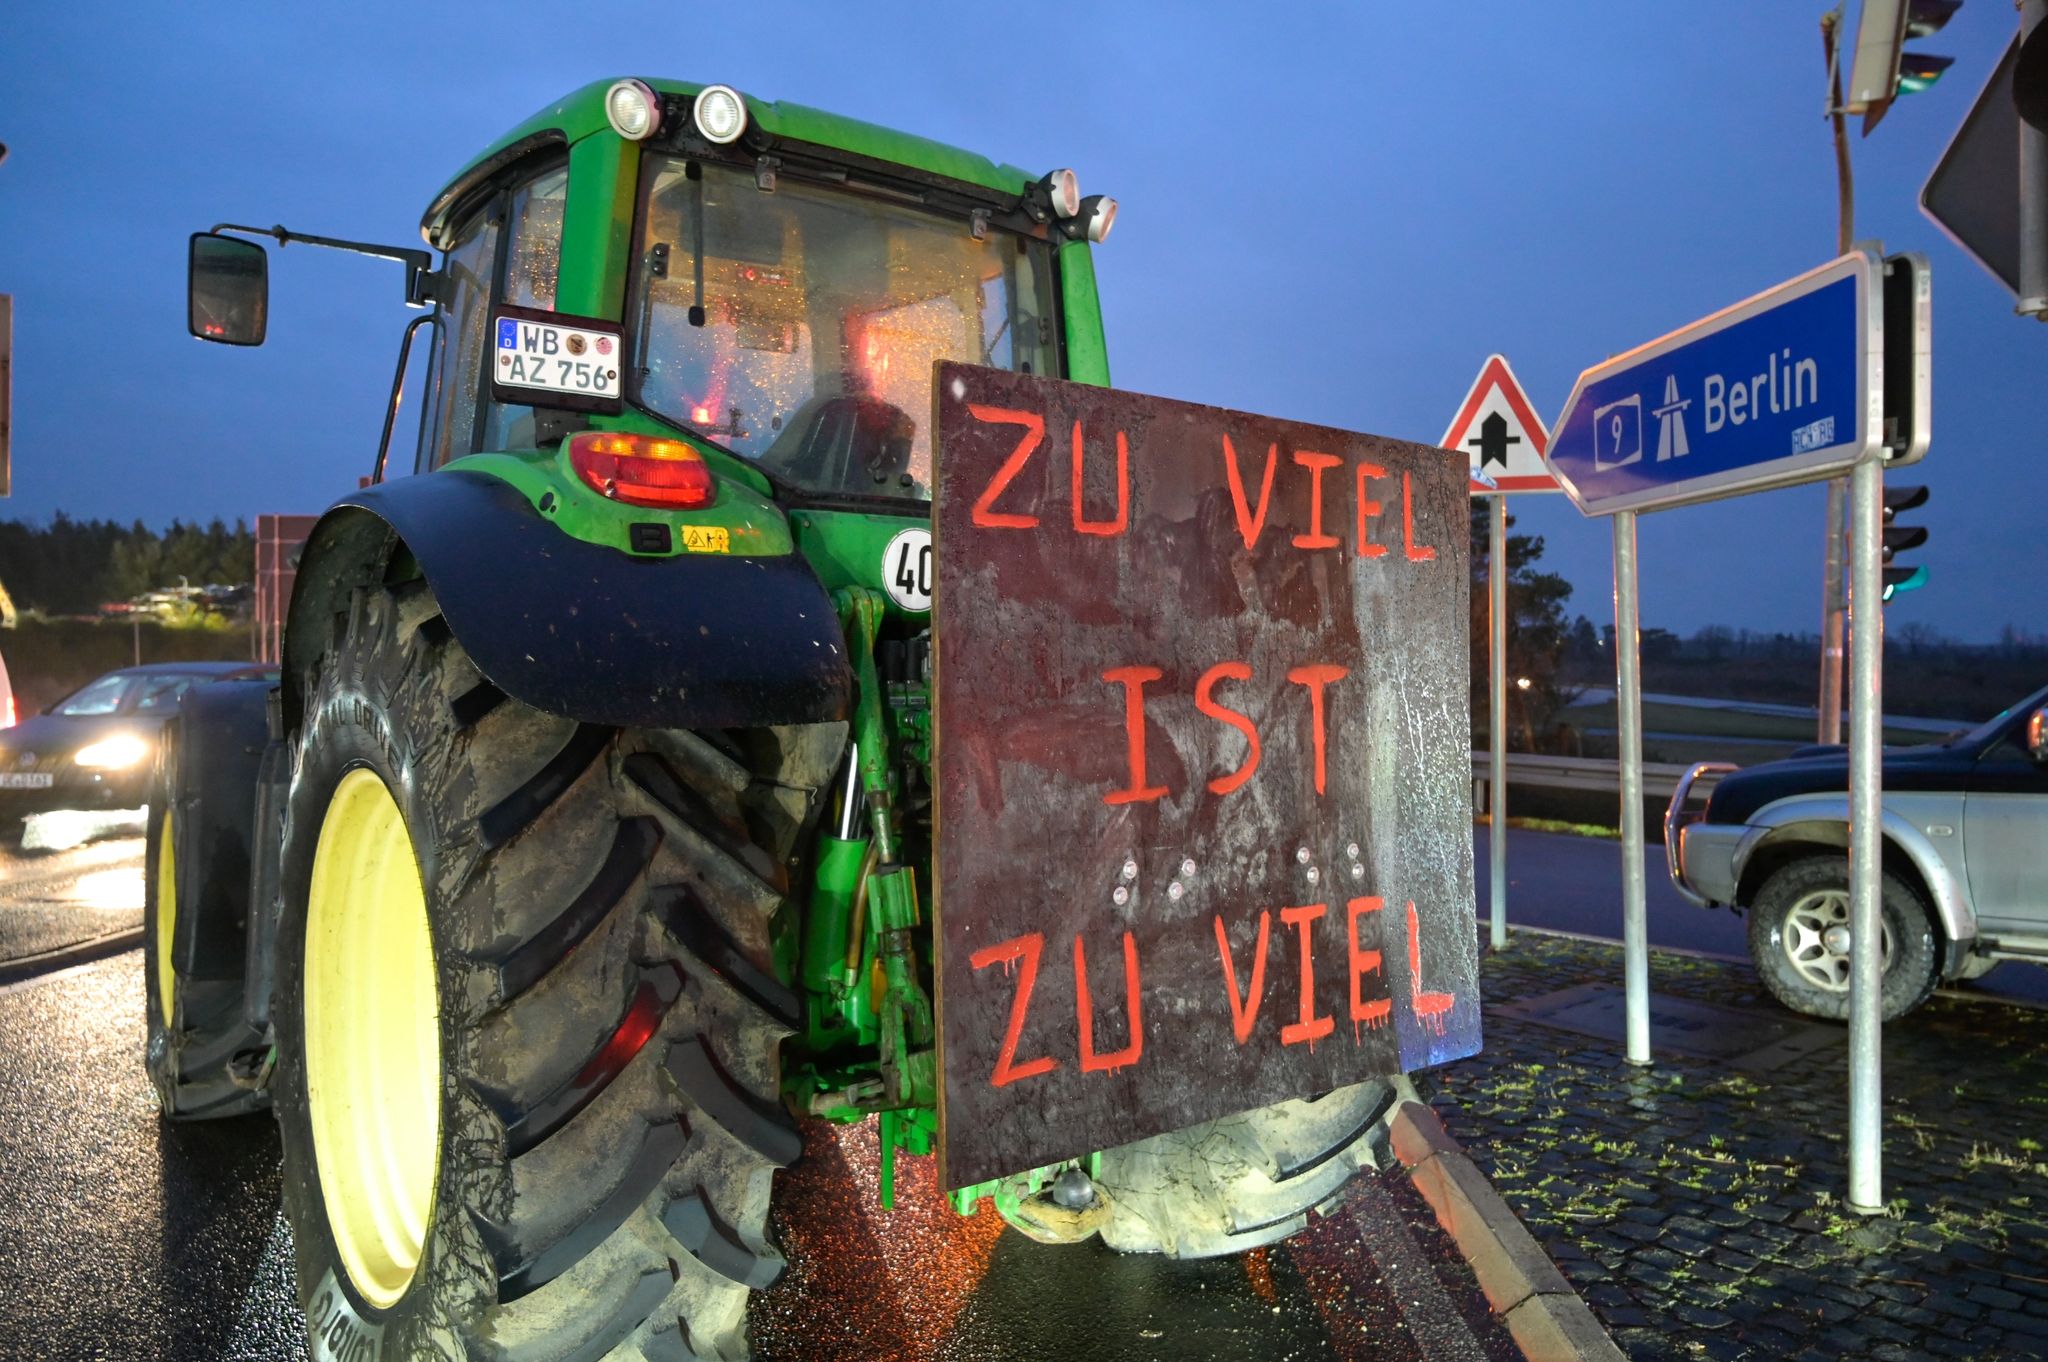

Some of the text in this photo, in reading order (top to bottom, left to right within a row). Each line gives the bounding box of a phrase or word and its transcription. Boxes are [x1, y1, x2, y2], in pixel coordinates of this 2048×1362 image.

[504, 338, 512, 347] D
[510, 354, 608, 390] AZ 756
[523, 325, 559, 355] WB
[1704, 348, 1818, 434] Berlin
[1611, 415, 1622, 454] 9
[968, 403, 1437, 562] ZU VIEL
[895, 543, 931, 596] 40
[354, 698, 401, 783] DRIVE
[1103, 661, 1349, 804] IST
[969, 896, 1455, 1086] ZU VIEL
